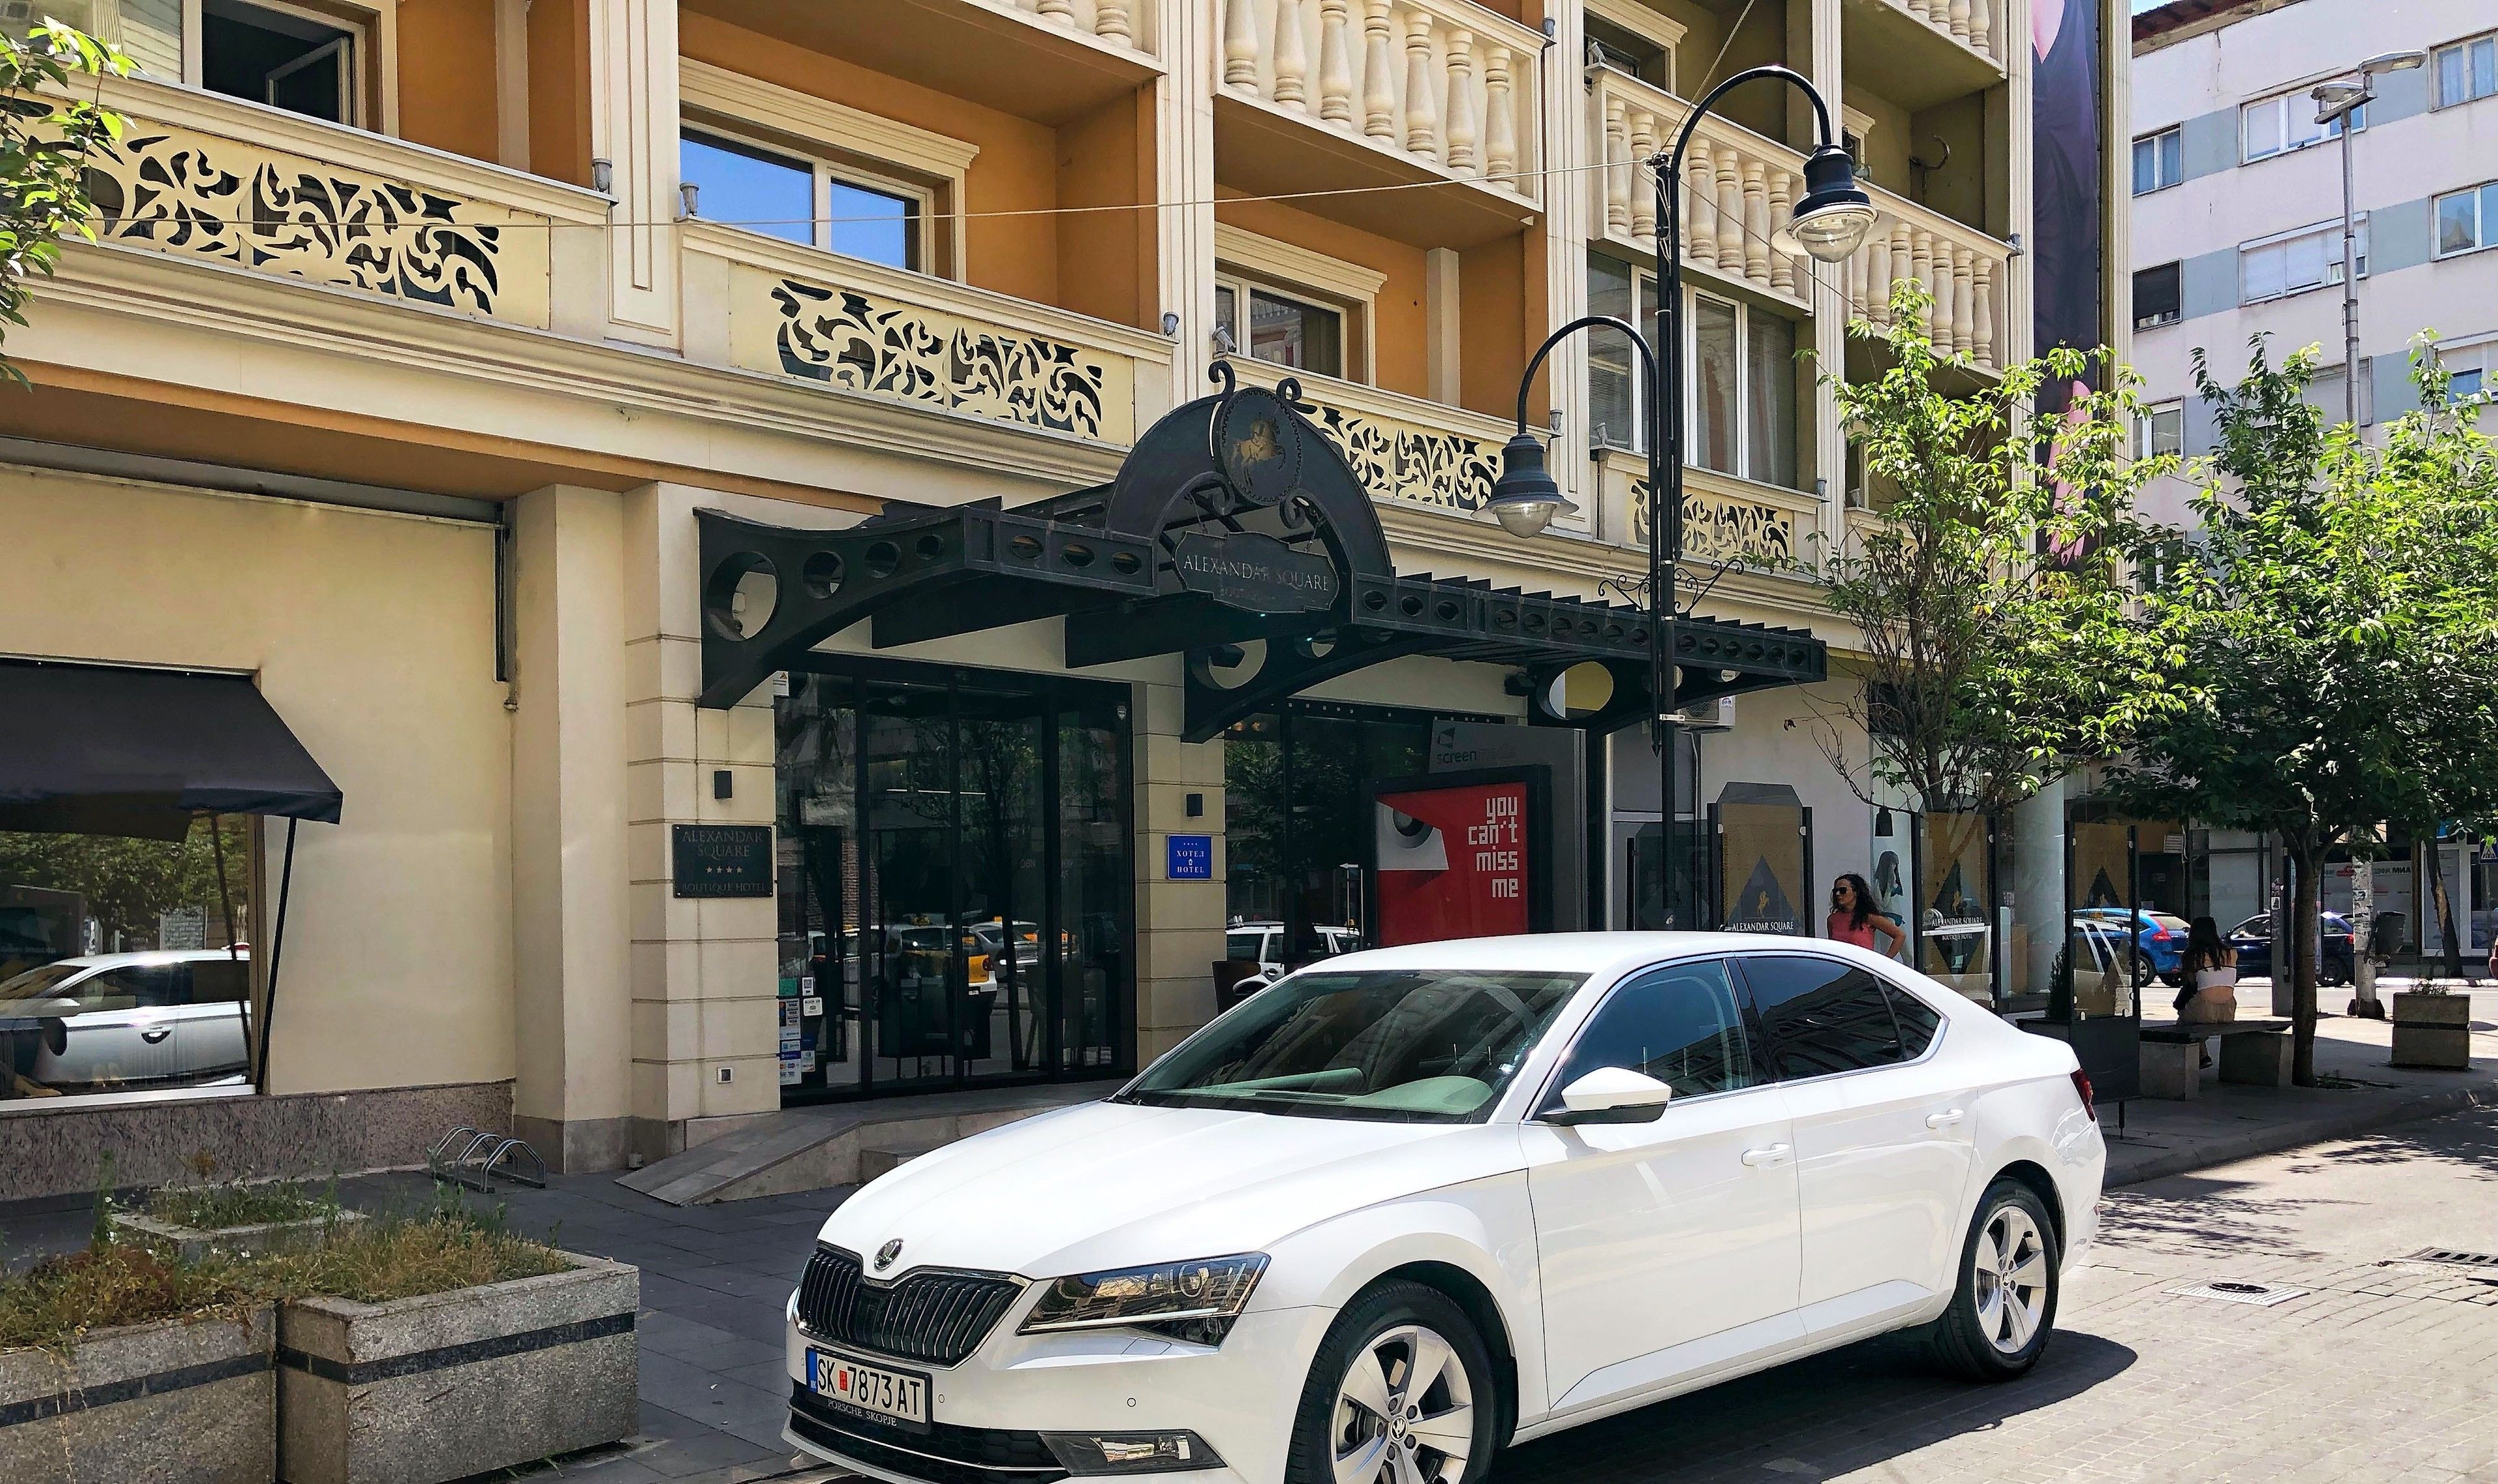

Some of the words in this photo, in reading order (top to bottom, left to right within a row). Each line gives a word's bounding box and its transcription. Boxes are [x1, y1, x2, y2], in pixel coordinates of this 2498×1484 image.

[1183, 555, 1269, 581] ALEXANDAR
[1277, 570, 1329, 592] SQUARE
[1436, 751, 1477, 764] screen
[1486, 797, 1518, 824] you
[682, 830, 762, 843] ALEXANDAR
[1468, 817, 1518, 845] can't
[698, 845, 750, 860] SQUARE
[1476, 845, 1518, 871] miss
[682, 882, 732, 894] BOUTIQUE
[736, 882, 766, 892] HOTEL
[1492, 878, 1518, 898] me
[1732, 922, 1769, 932] ALEXANDAR
[1770, 921, 1793, 932] SQUARE
[818, 1358, 837, 1395] SK
[827, 1399, 863, 1417] PORSCHE
[866, 1411, 897, 1426] SKOPJE
